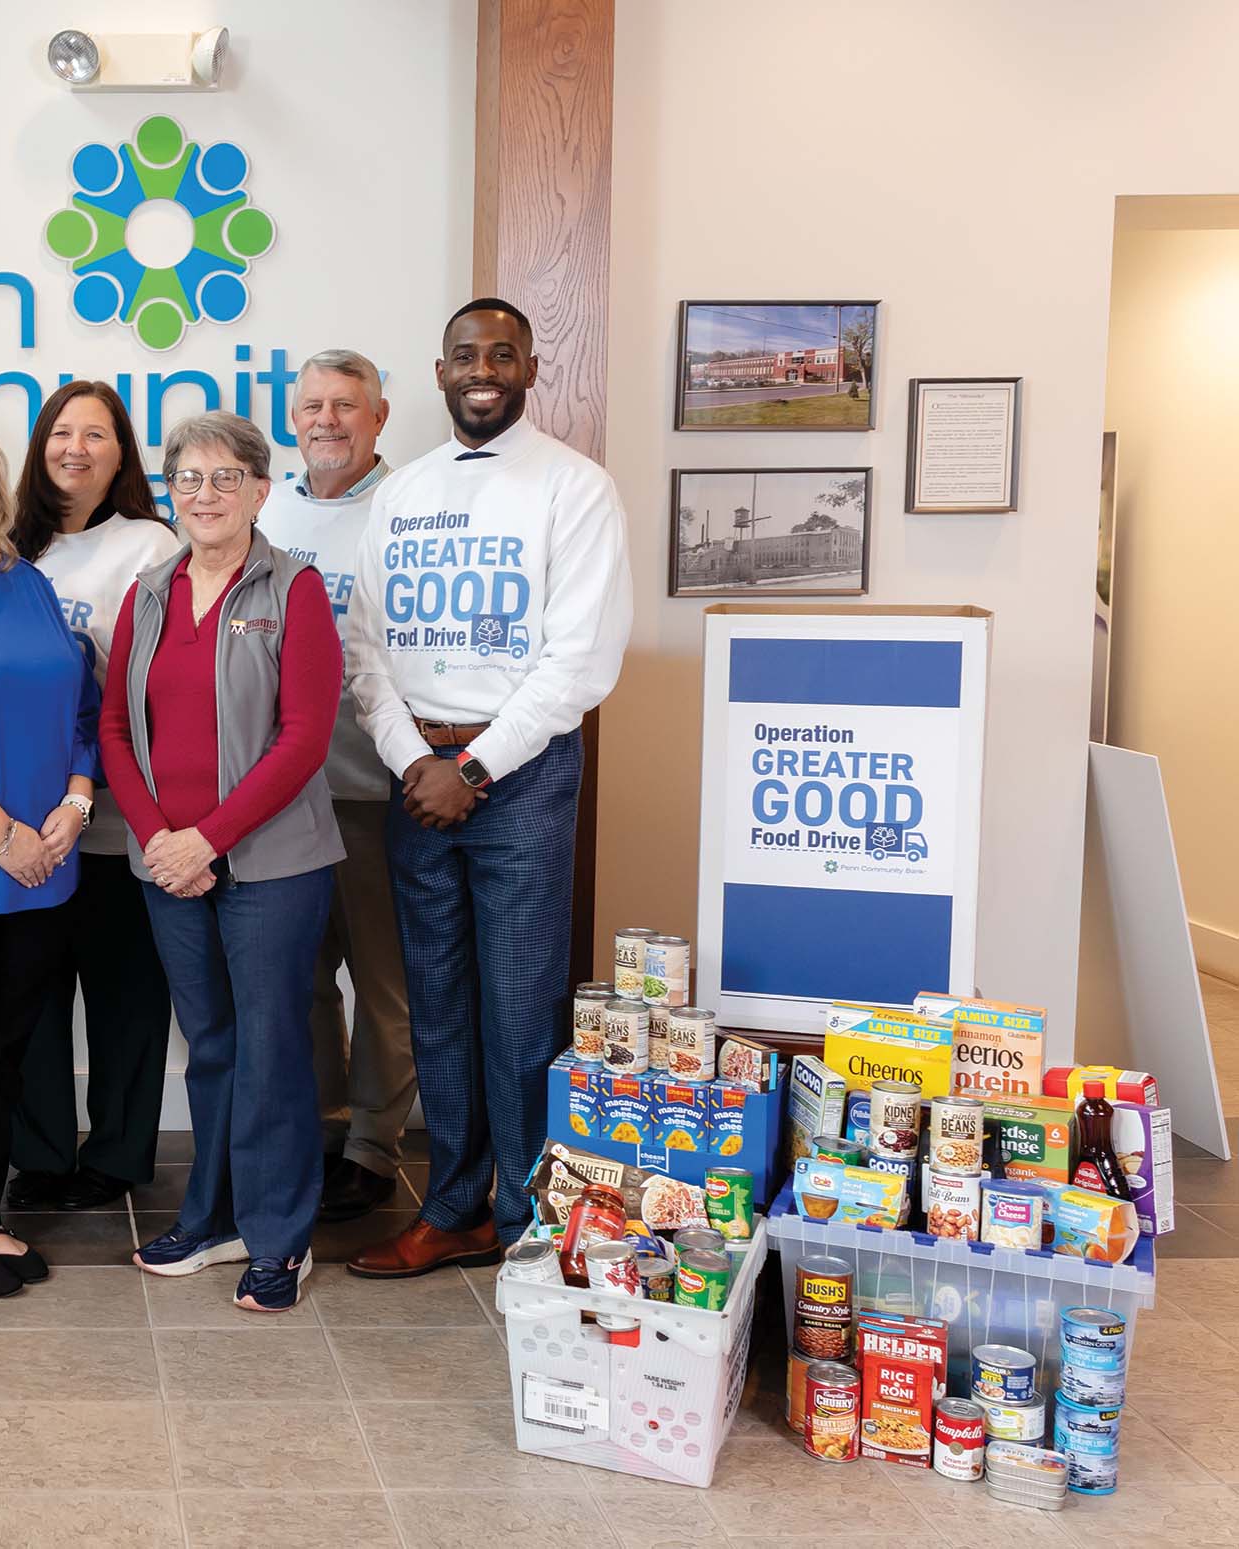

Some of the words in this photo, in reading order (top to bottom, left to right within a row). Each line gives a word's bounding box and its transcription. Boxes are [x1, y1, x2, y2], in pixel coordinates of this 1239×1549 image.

[391, 511, 469, 536] Operation
[385, 536, 523, 570] GREATER
[385, 571, 530, 623] GOOD
[424, 627, 467, 648] Drive
[754, 723, 854, 744] Operation
[752, 748, 914, 781] GREATER
[752, 779, 923, 830] GOOD
[751, 828, 800, 847] Food
[807, 831, 861, 850] Drive
[861, 865, 904, 874] Community
[617, 949, 637, 962] EAS
[649, 1020, 667, 1033] ANS
[953, 1010, 999, 1025] FAMILY
[1003, 1016, 1030, 1029] SIZE
[867, 1021, 909, 1037] LARGE
[913, 1029, 941, 1041] SIZE
[957, 1043, 1024, 1070] eerios
[848, 1055, 923, 1086] Cheerios
[795, 1064, 821, 1094] GOYA
[570, 1091, 597, 1104] aroni
[604, 1099, 649, 1112] macaroni
[658, 1106, 703, 1119] macaroni
[884, 1105, 916, 1118] KIDNEY
[610, 1110, 643, 1122] cheese
[663, 1117, 697, 1129] cheese
[952, 1112, 976, 1120] pinto
[719, 1123, 743, 1131] chee
[941, 1118, 976, 1132] BEANS
[1028, 1132, 1040, 1141] of
[1051, 1128, 1061, 1139] 6
[640, 1151, 666, 1161] cheese
[564, 1161, 619, 1184] AGHETTI
[868, 1158, 909, 1175] GOYA
[1004, 1166, 1037, 1177] rganic
[814, 1176, 832, 1187] Dole
[1074, 1178, 1102, 1189] Original
[999, 1201, 1026, 1212] Cream
[998, 1209, 1027, 1220] Cheese
[806, 1282, 844, 1298] BUSH'S
[798, 1300, 831, 1315] Country
[831, 1306, 851, 1317] Style
[863, 1333, 942, 1364] HELPER
[644, 1374, 660, 1382] TARE
[661, 1377, 686, 1387] WEIGHT
[880, 1368, 914, 1384] RICE
[880, 1384, 914, 1400] RONI
[816, 1394, 853, 1409] CHUNKY
[872, 1402, 902, 1413] SPANISH
[903, 1407, 920, 1416] RICE
